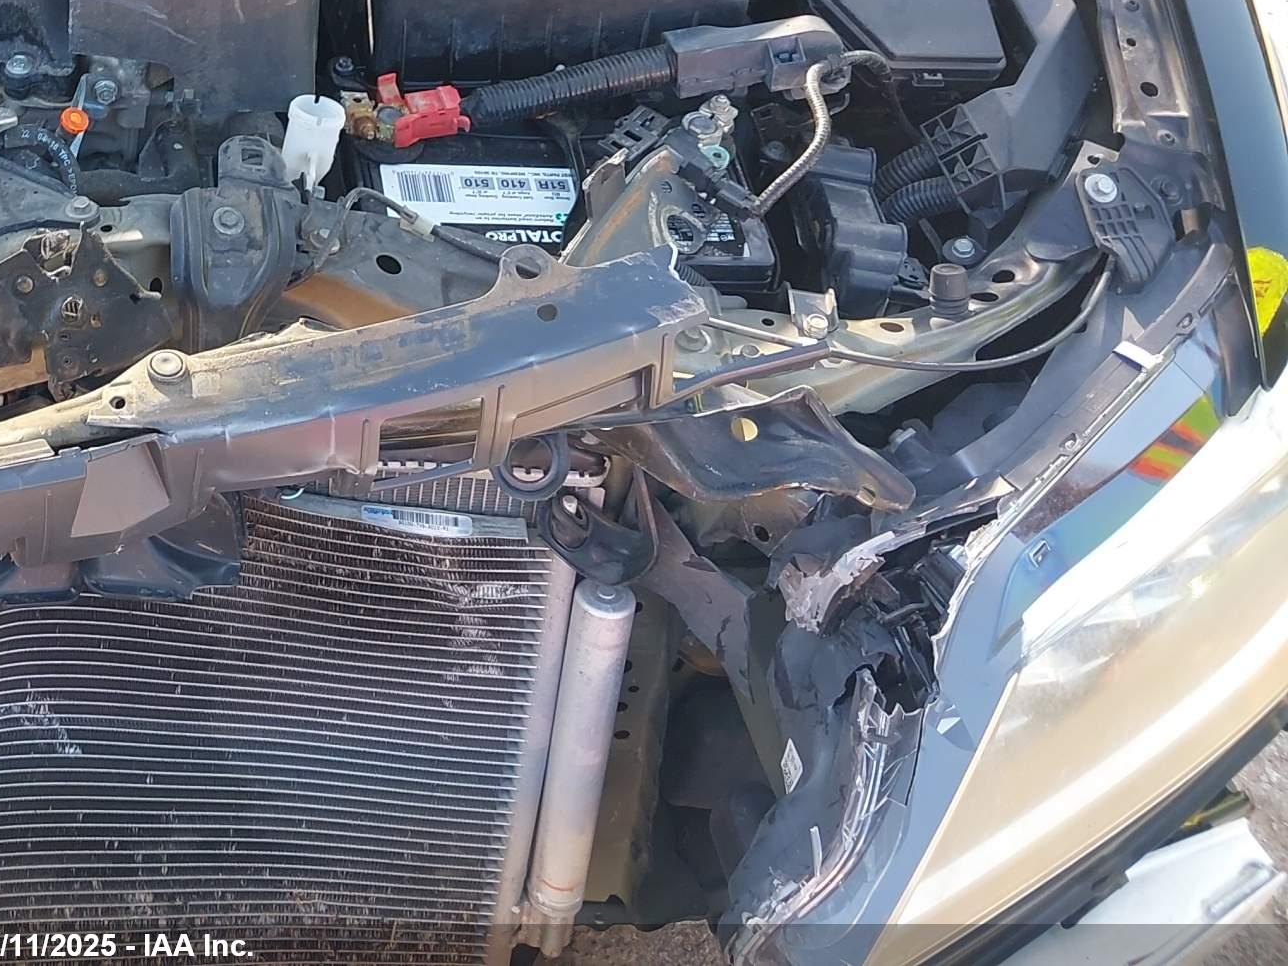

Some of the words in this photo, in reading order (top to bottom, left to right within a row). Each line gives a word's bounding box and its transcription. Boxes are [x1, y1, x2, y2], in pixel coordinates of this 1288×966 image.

[464, 178, 489, 188] 510
[501, 179, 526, 189] 410
[539, 180, 566, 190] 51R
